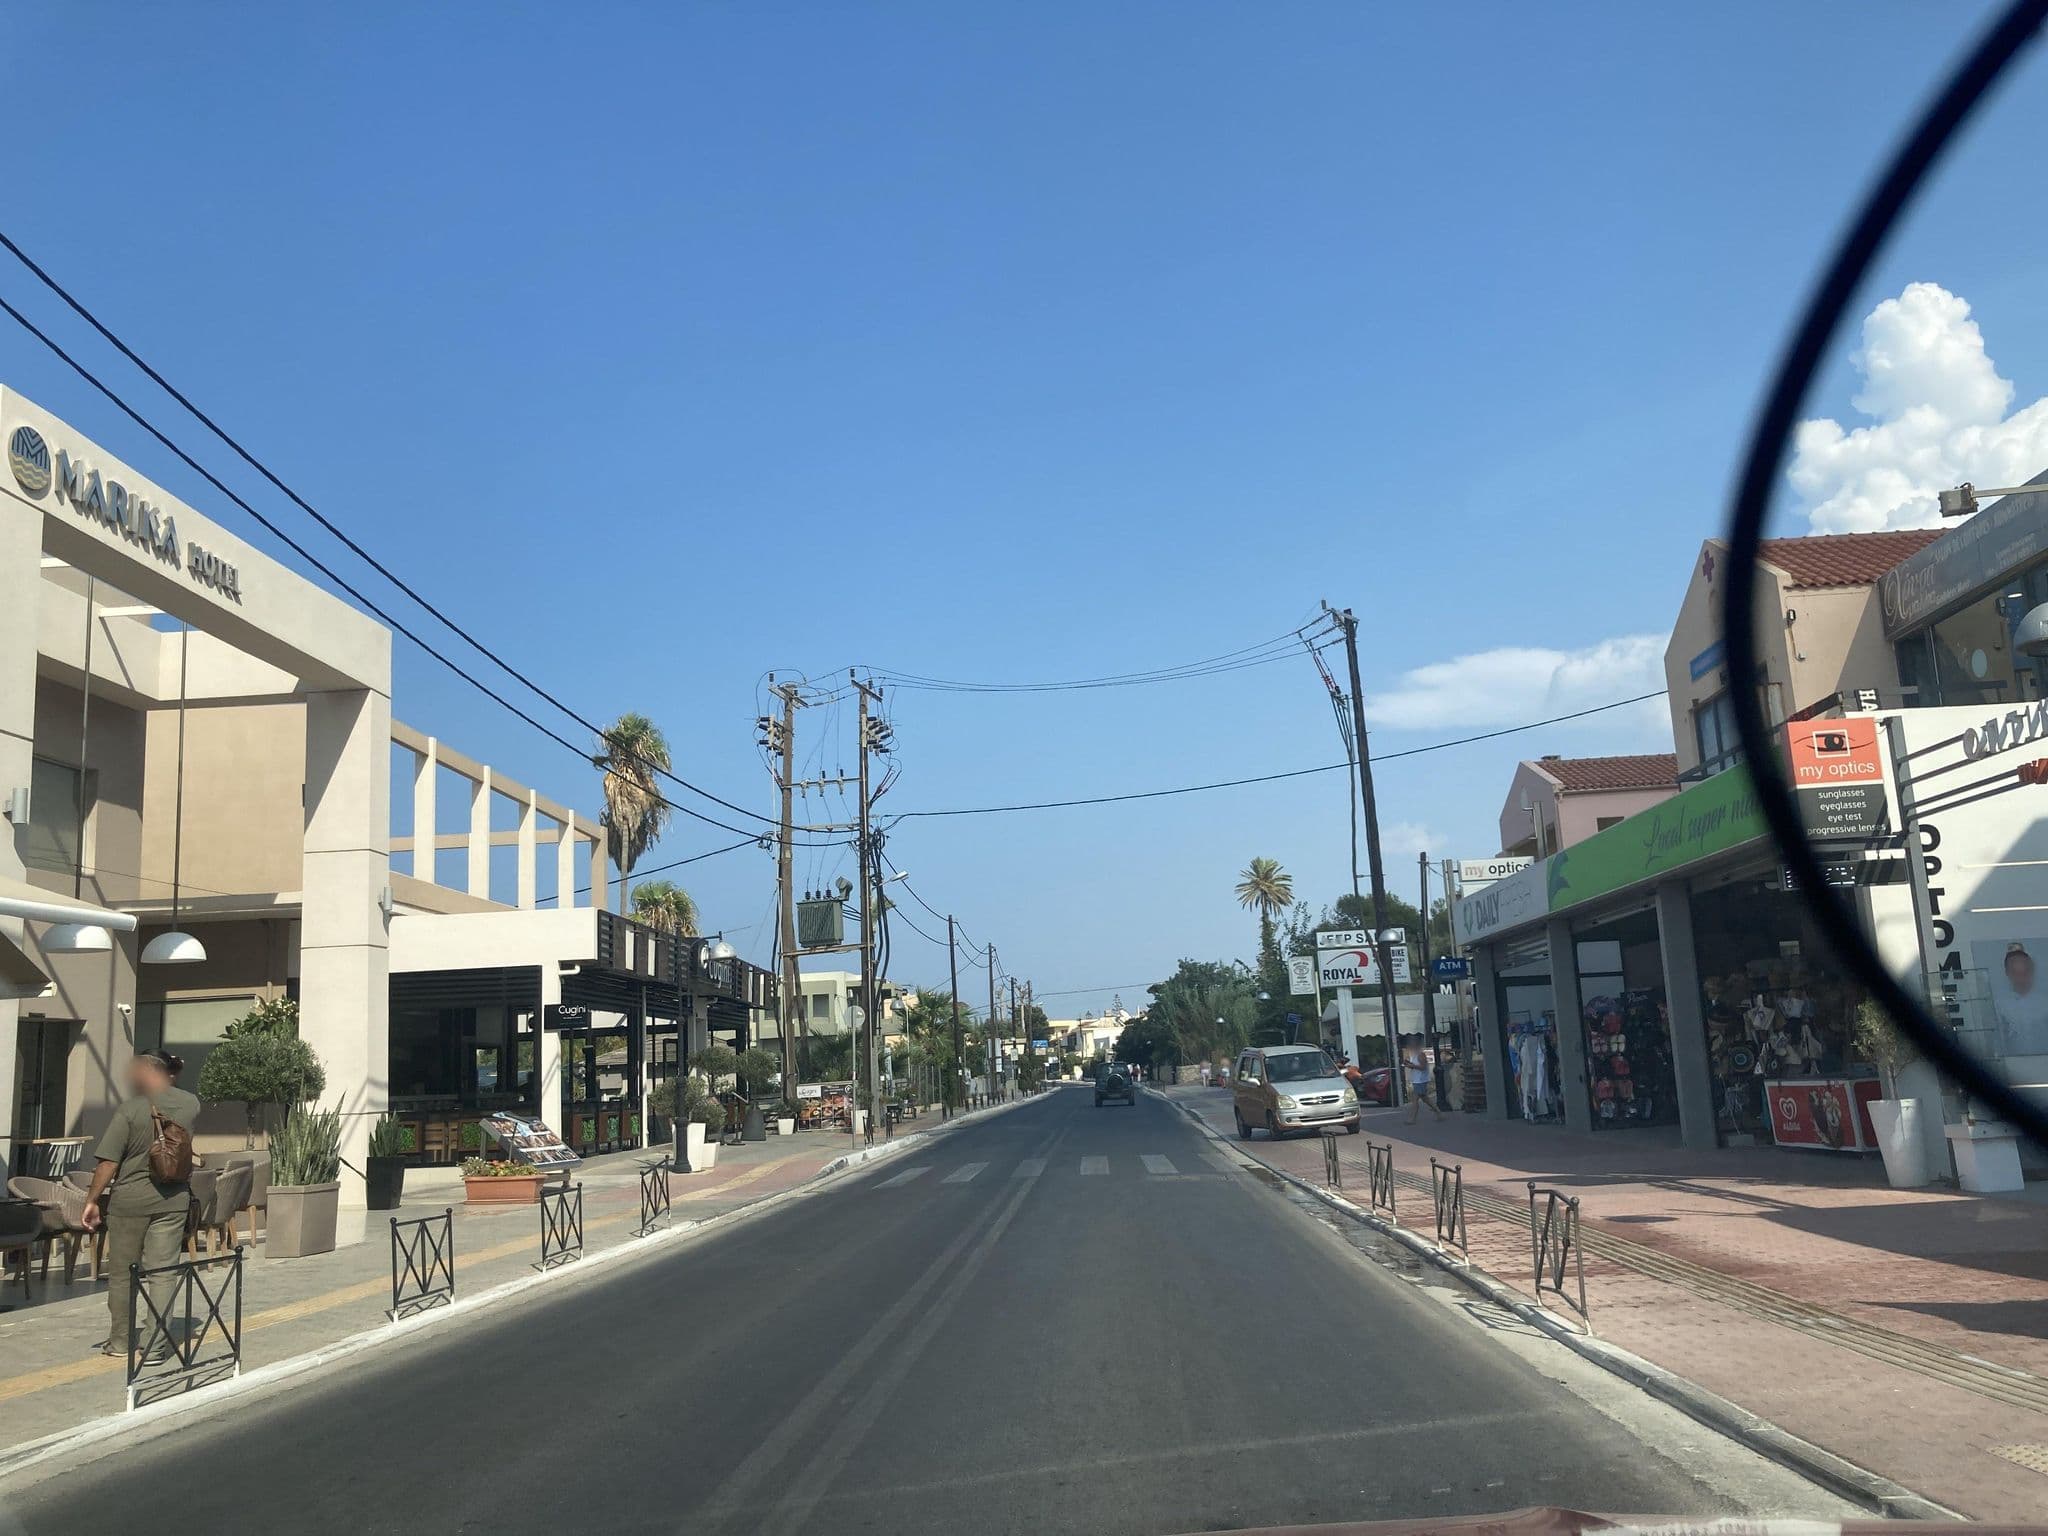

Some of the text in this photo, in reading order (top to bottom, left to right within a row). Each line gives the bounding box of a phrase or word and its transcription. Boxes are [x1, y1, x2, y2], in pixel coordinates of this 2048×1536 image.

[55, 448, 242, 596] MARIKA HOTEL
[1800, 761, 1876, 779] my optics
[1818, 789, 1865, 800] sunglasses
[1820, 800, 1867, 812] eyeglasses
[1827, 812, 1862, 823] eye test
[1807, 822, 1887, 836] progressive lenses
[1464, 865, 1485, 878] my
[1475, 890, 1500, 931] DAILY
[1439, 961, 1461, 970] ATM
[1323, 967, 1362, 980] ROYAL
[558, 1004, 586, 1016] Cugini
